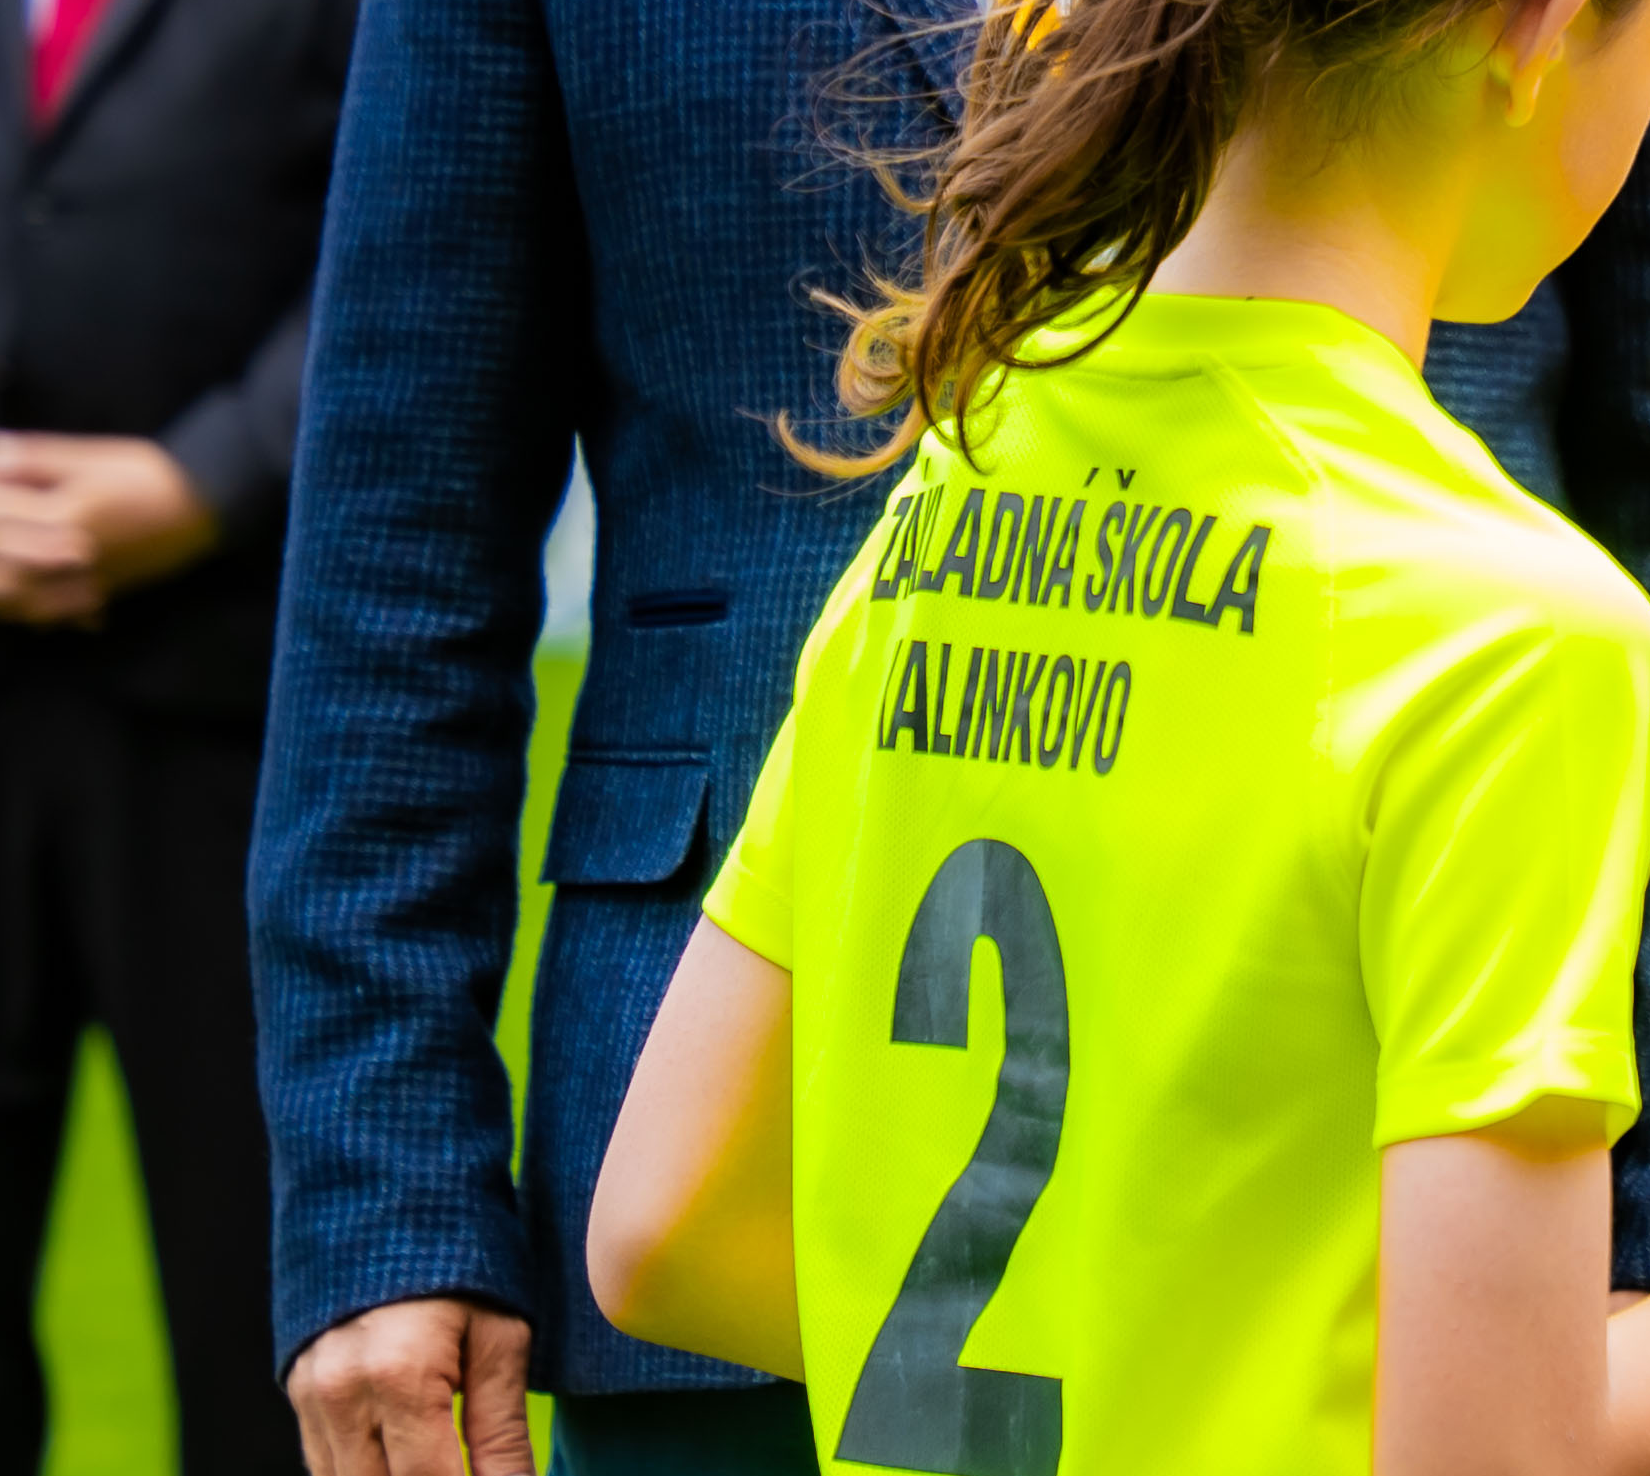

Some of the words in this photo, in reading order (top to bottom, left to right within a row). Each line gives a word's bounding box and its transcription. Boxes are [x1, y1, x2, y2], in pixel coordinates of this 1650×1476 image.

[870, 456, 1100, 613] ZÁLADNÁ
[1083, 467, 1272, 637] ŠKOLA
[876, 637, 1133, 778] ALINKOVO
